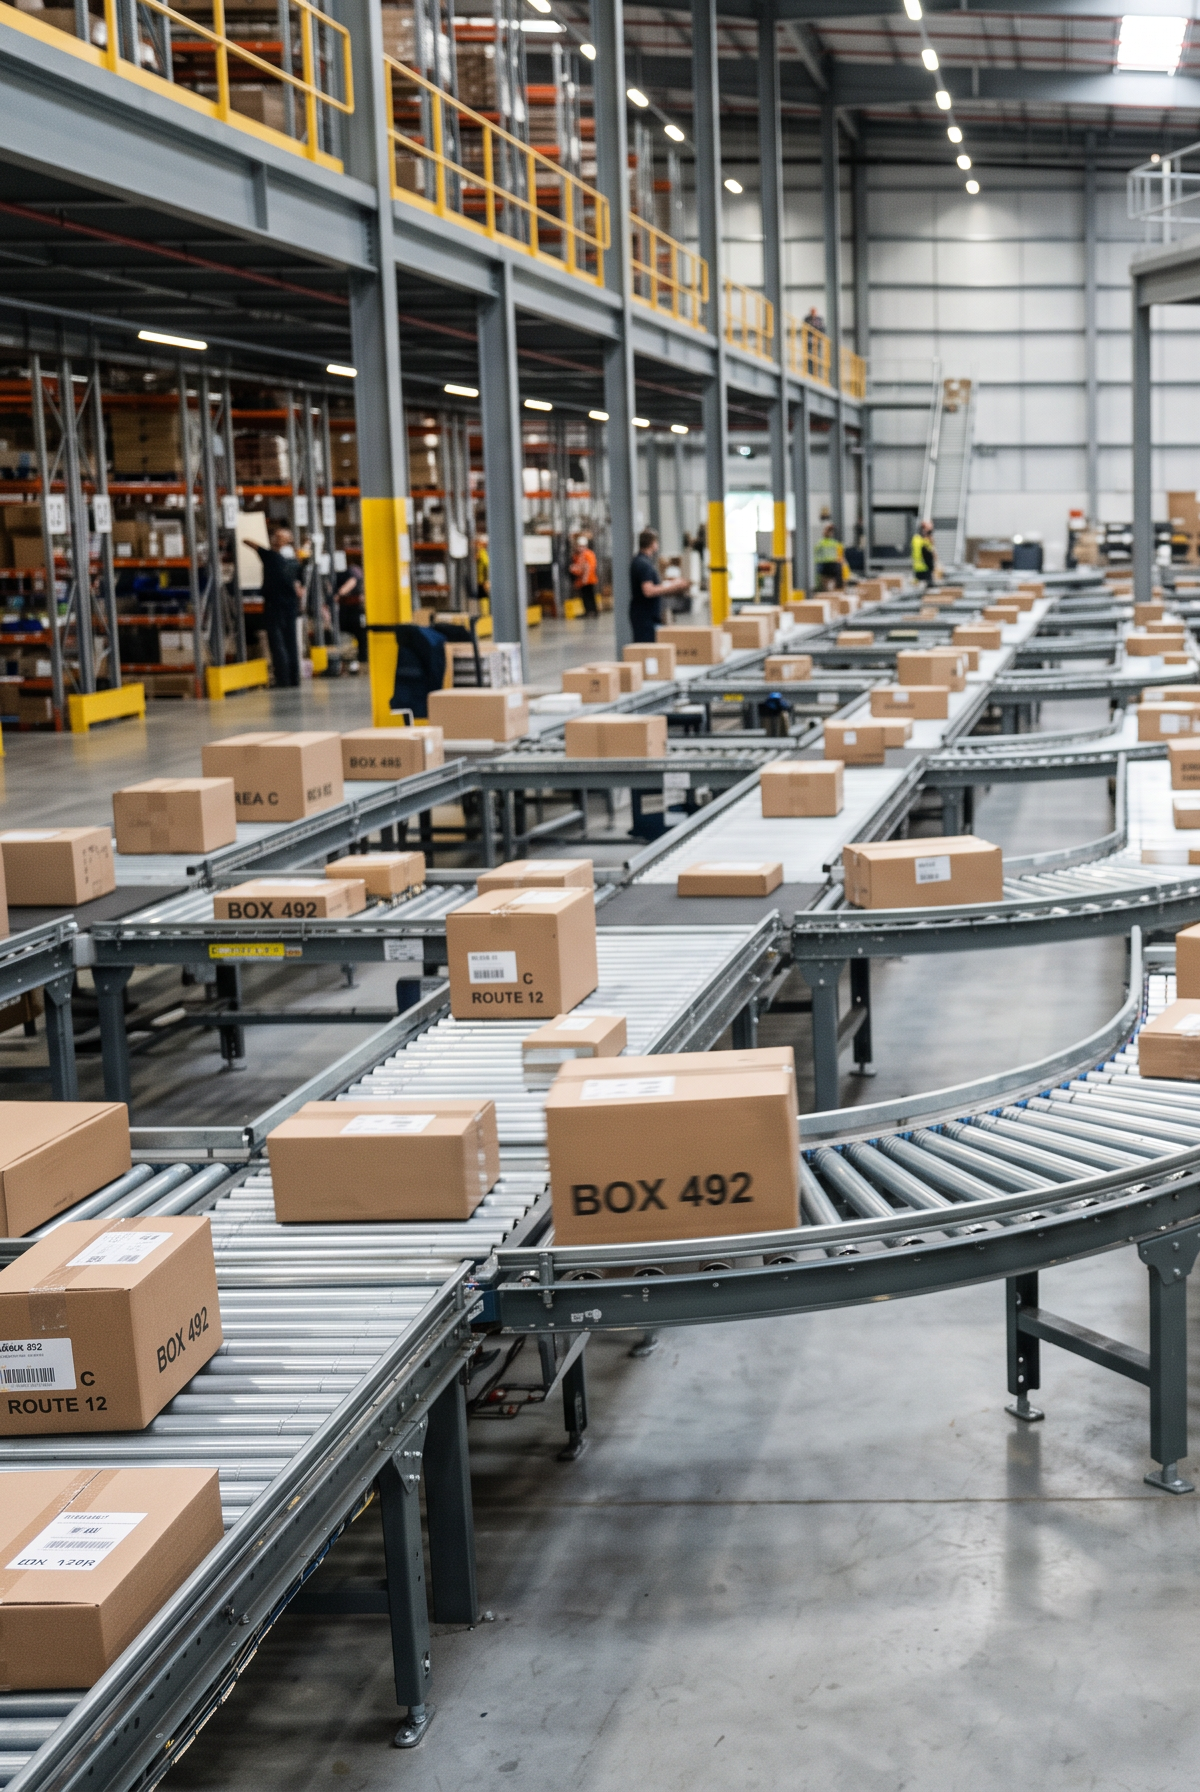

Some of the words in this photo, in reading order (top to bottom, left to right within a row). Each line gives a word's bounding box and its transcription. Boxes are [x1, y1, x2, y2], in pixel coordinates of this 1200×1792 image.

[349, 756, 377, 769] BOX
[267, 791, 279, 807] C
[227, 901, 275, 919] BOX
[280, 901, 318, 918] 492
[522, 972, 534, 985] C
[471, 991, 524, 1004] ROUTE
[528, 991, 544, 1004] 12
[571, 1177, 668, 1217] BOX
[678, 1171, 754, 1207] 492
[156, 1327, 186, 1374] BOX
[188, 1306, 209, 1342] 492
[80, 1370, 96, 1387] C
[7, 1397, 80, 1415] ROUTE
[85, 1396, 108, 1412] 12
